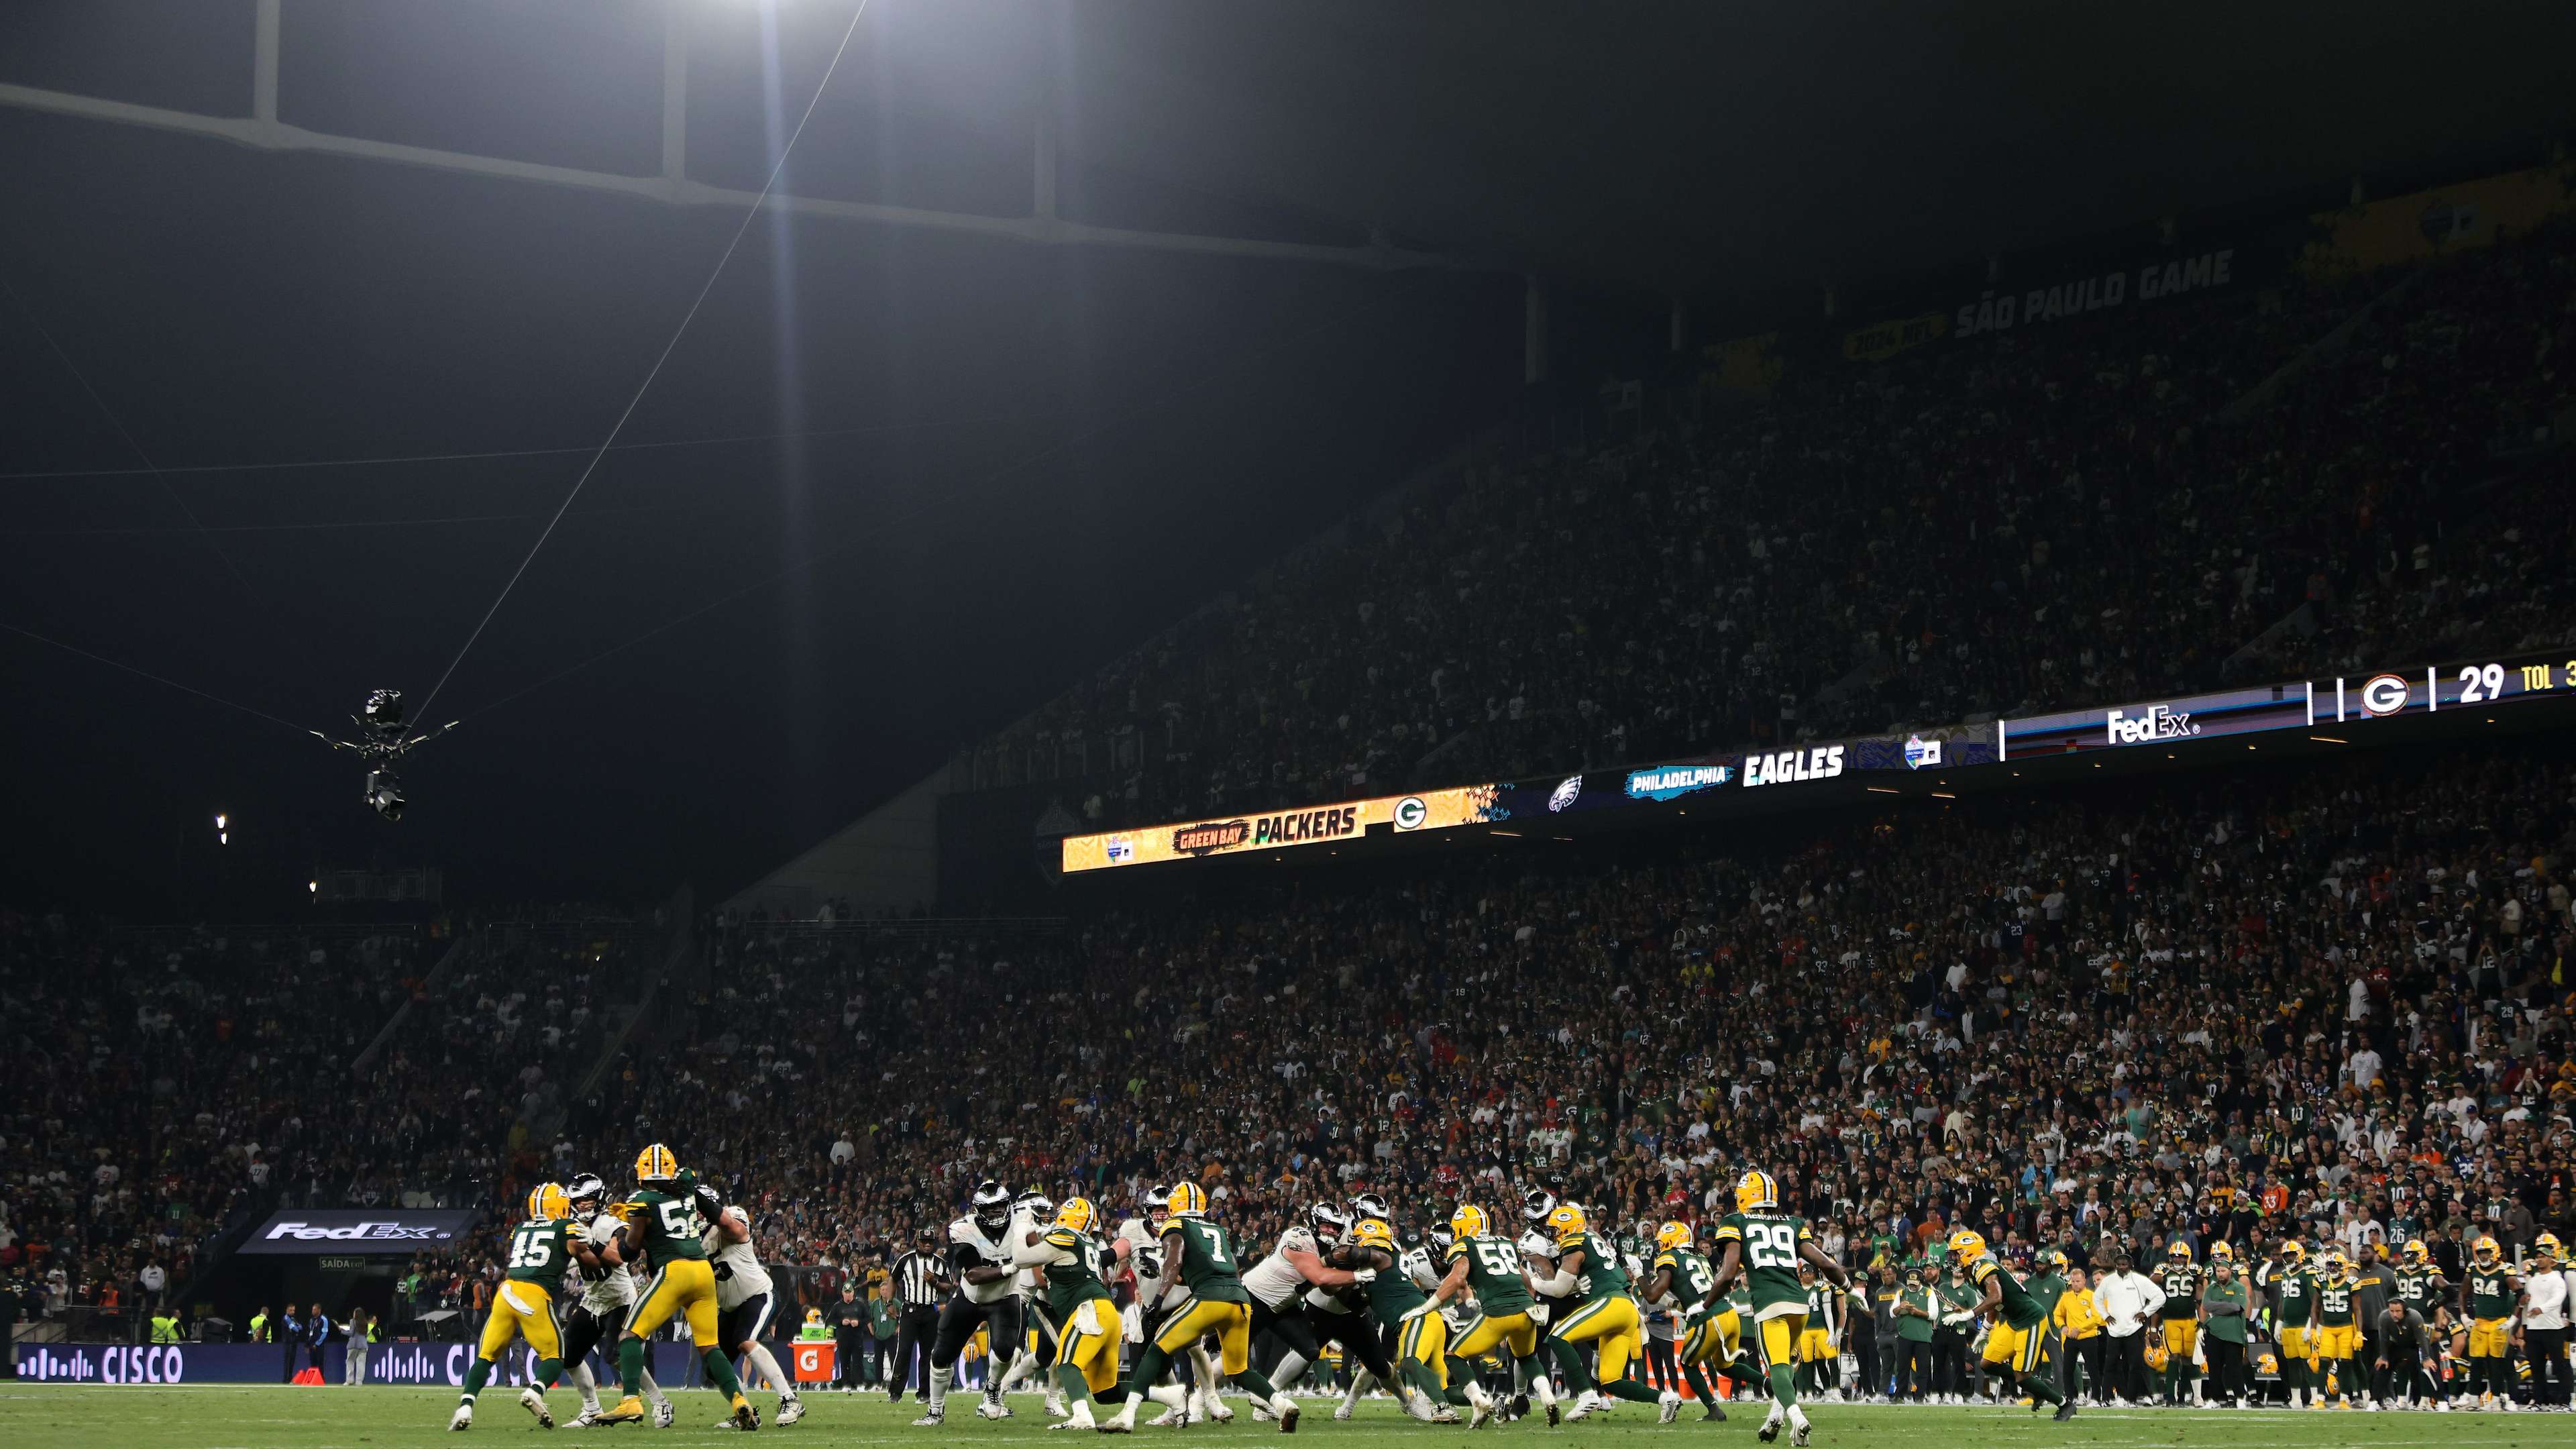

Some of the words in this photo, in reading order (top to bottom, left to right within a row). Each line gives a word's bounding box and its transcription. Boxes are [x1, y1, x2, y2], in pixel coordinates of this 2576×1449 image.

[1955, 289, 2015, 338] SÃO
[2024, 271, 2125, 325] PAULO
[2138, 248, 2234, 301] GAME
[2459, 663, 2505, 704] 29
[2521, 663, 2554, 692] TOL
[2108, 705, 2192, 745] FedEx
[1631, 767, 1726, 793] PHILADELPHIA
[1743, 746, 1845, 787] EAGLES
[1179, 829, 1219, 850] GREEN
[1218, 826, 1242, 846] BAY
[1254, 806, 1356, 845] PACKERS
[2010, 926, 2023, 936] 23
[2502, 1006, 2514, 1018] 29
[2291, 1107, 2304, 1122] 10
[900, 1121, 908, 1132] 10
[1379, 1120, 1389, 1132] 12
[1535, 1157, 1548, 1168] 12
[2264, 1194, 2276, 1209] 33
[2391, 1187, 2405, 1202] 10
[265, 1222, 437, 1240] FedEx
[2357, 1232, 2365, 1246] 1
[2390, 1228, 2405, 1244] 26
[508, 1231, 556, 1269] 45
[1199, 1226, 1228, 1263] 7
[1640, 1245, 1653, 1260] 23
[1745, 1223, 1799, 1269] 29
[321, 1258, 350, 1269] SAÍDA
[1476, 1242, 1522, 1276] 58
[2165, 1275, 2194, 1298] 55
[2281, 1279, 2301, 1298] 96
[2398, 1277, 2424, 1300] 95
[2473, 1277, 2500, 1297] 84
[2321, 1290, 2349, 1313] 25
[103, 1346, 183, 1384] CISCO
[800, 1349, 818, 1372] G
